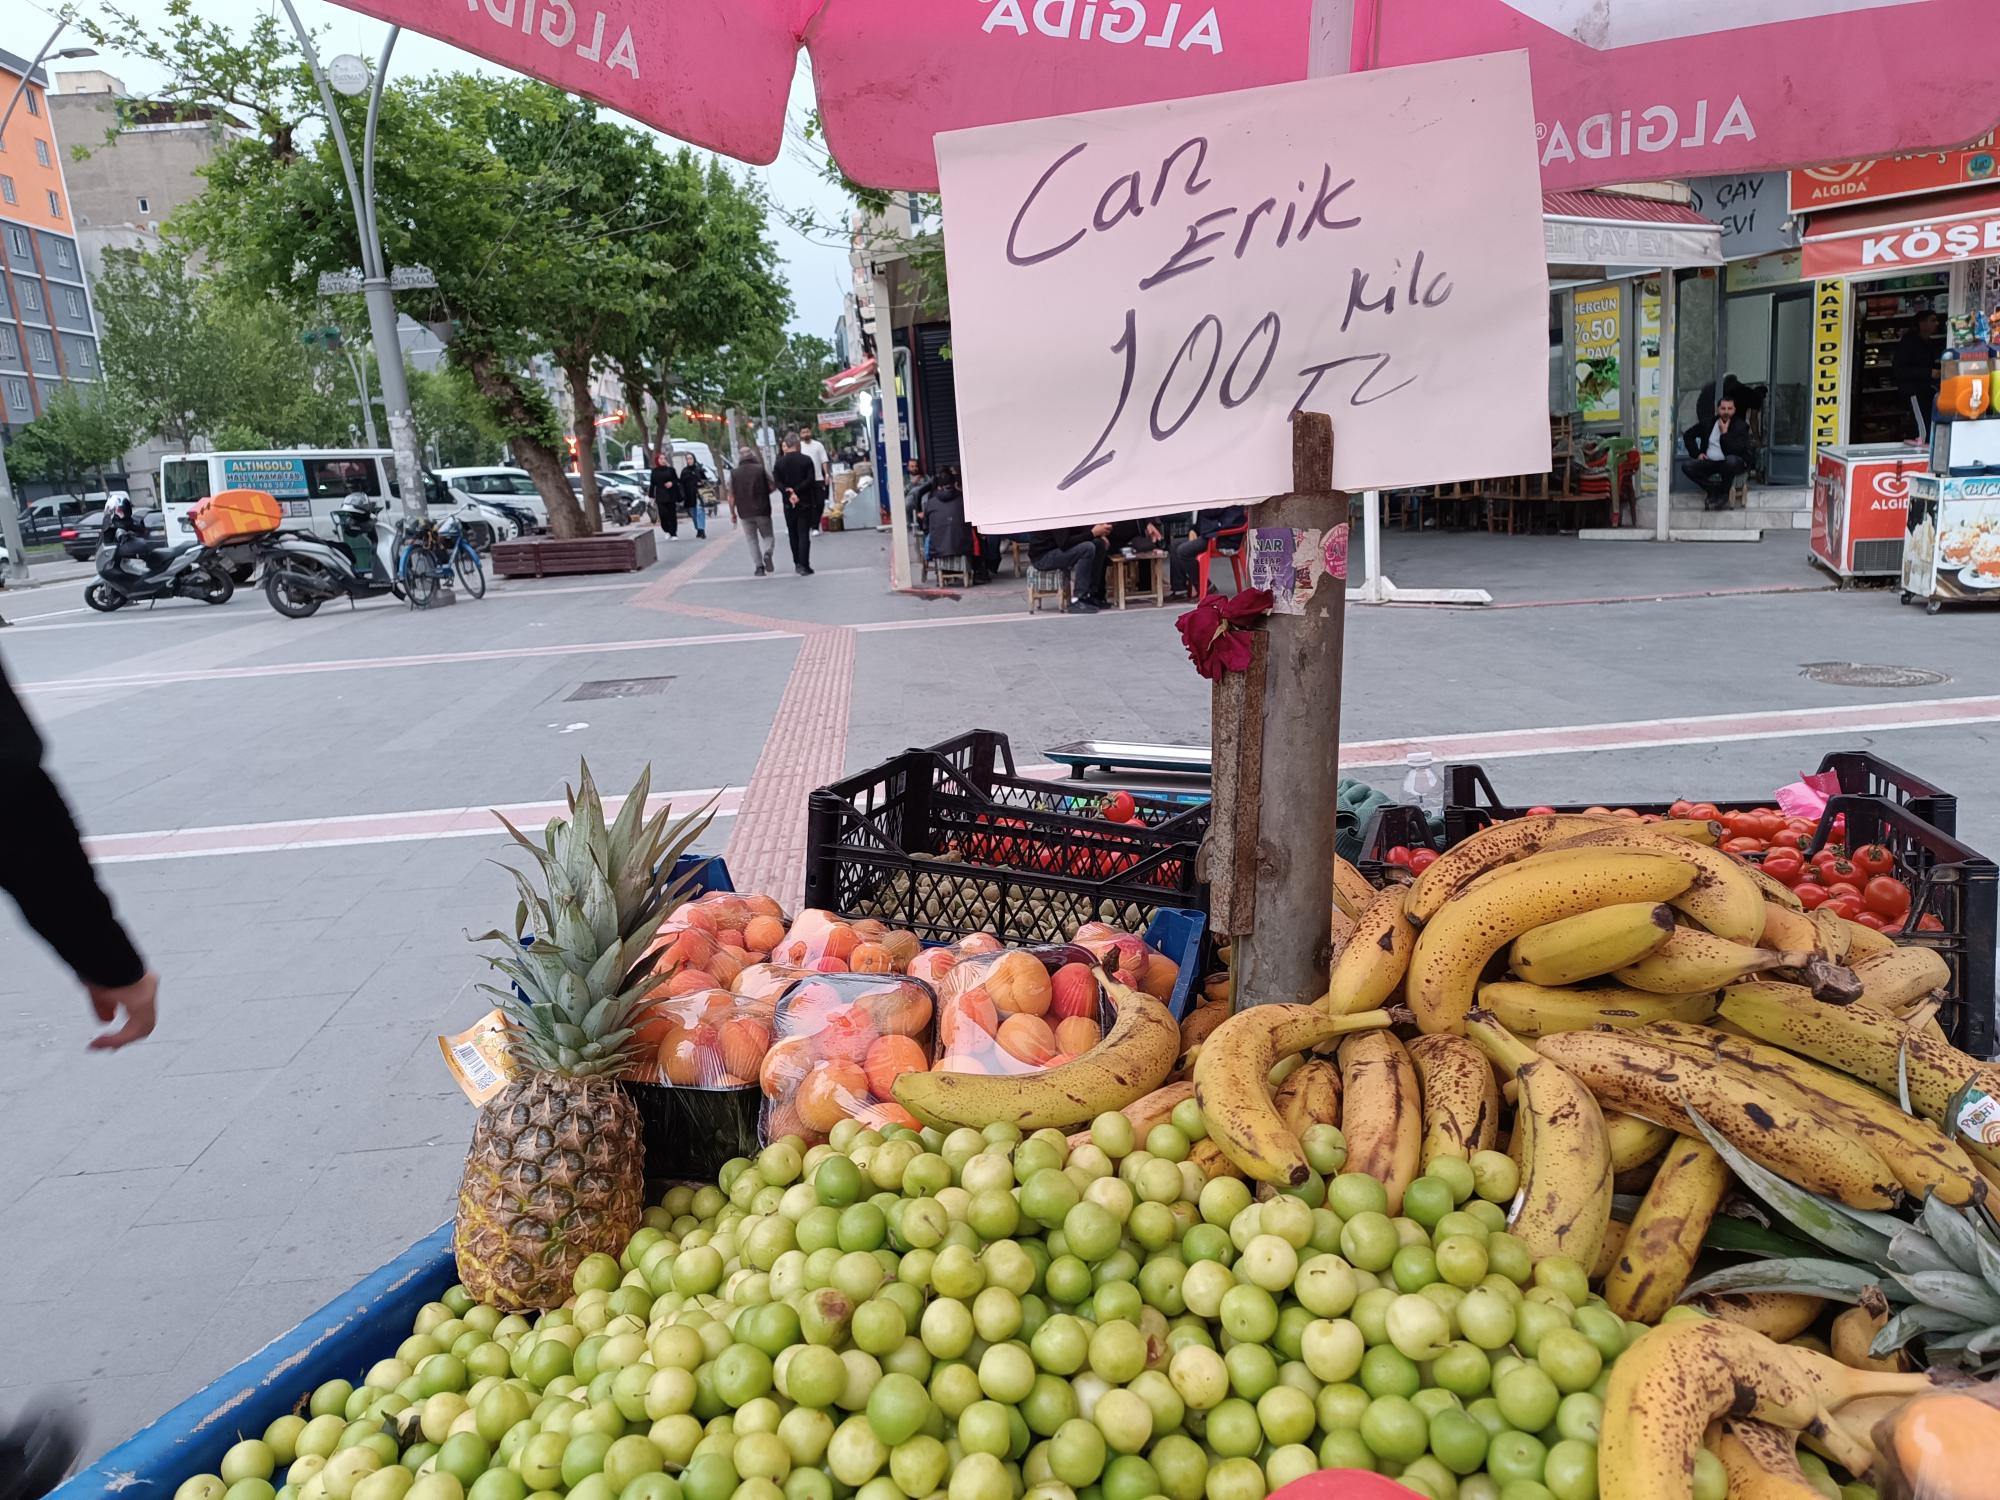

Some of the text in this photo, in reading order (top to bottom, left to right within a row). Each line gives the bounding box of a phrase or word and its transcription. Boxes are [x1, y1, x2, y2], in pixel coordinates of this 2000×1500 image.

[1006, 136, 1212, 266] Can
[1716, 177, 1764, 210] ÇAY
[1139, 163, 1362, 290] Erik
[1583, 227, 1629, 261] ÇAY
[1819, 280, 1840, 333] KART
[1057, 308, 1281, 491] 100
[1816, 342, 1838, 406] DOLUM
[232, 461, 293, 472] ALTINGOLD
